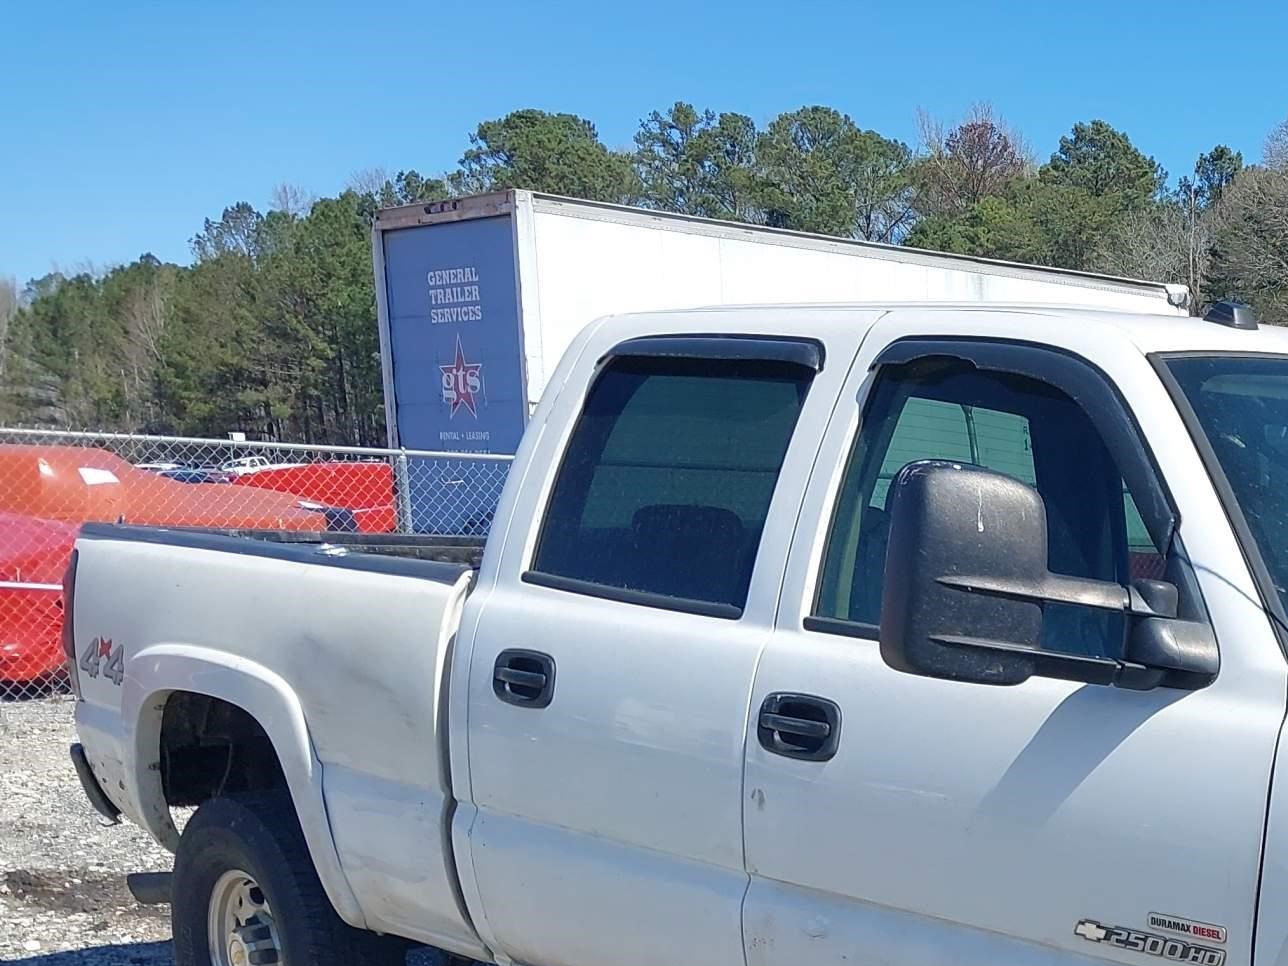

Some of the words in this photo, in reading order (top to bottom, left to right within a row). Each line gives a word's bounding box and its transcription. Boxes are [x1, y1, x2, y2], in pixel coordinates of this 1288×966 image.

[427, 267, 479, 286] GENERAL
[429, 285, 480, 305] TRAILER
[431, 305, 482, 324] SERVICES
[442, 367, 481, 403] gts
[1150, 916, 1192, 933] DURAMAX
[1192, 926, 1222, 940] DIESEL
